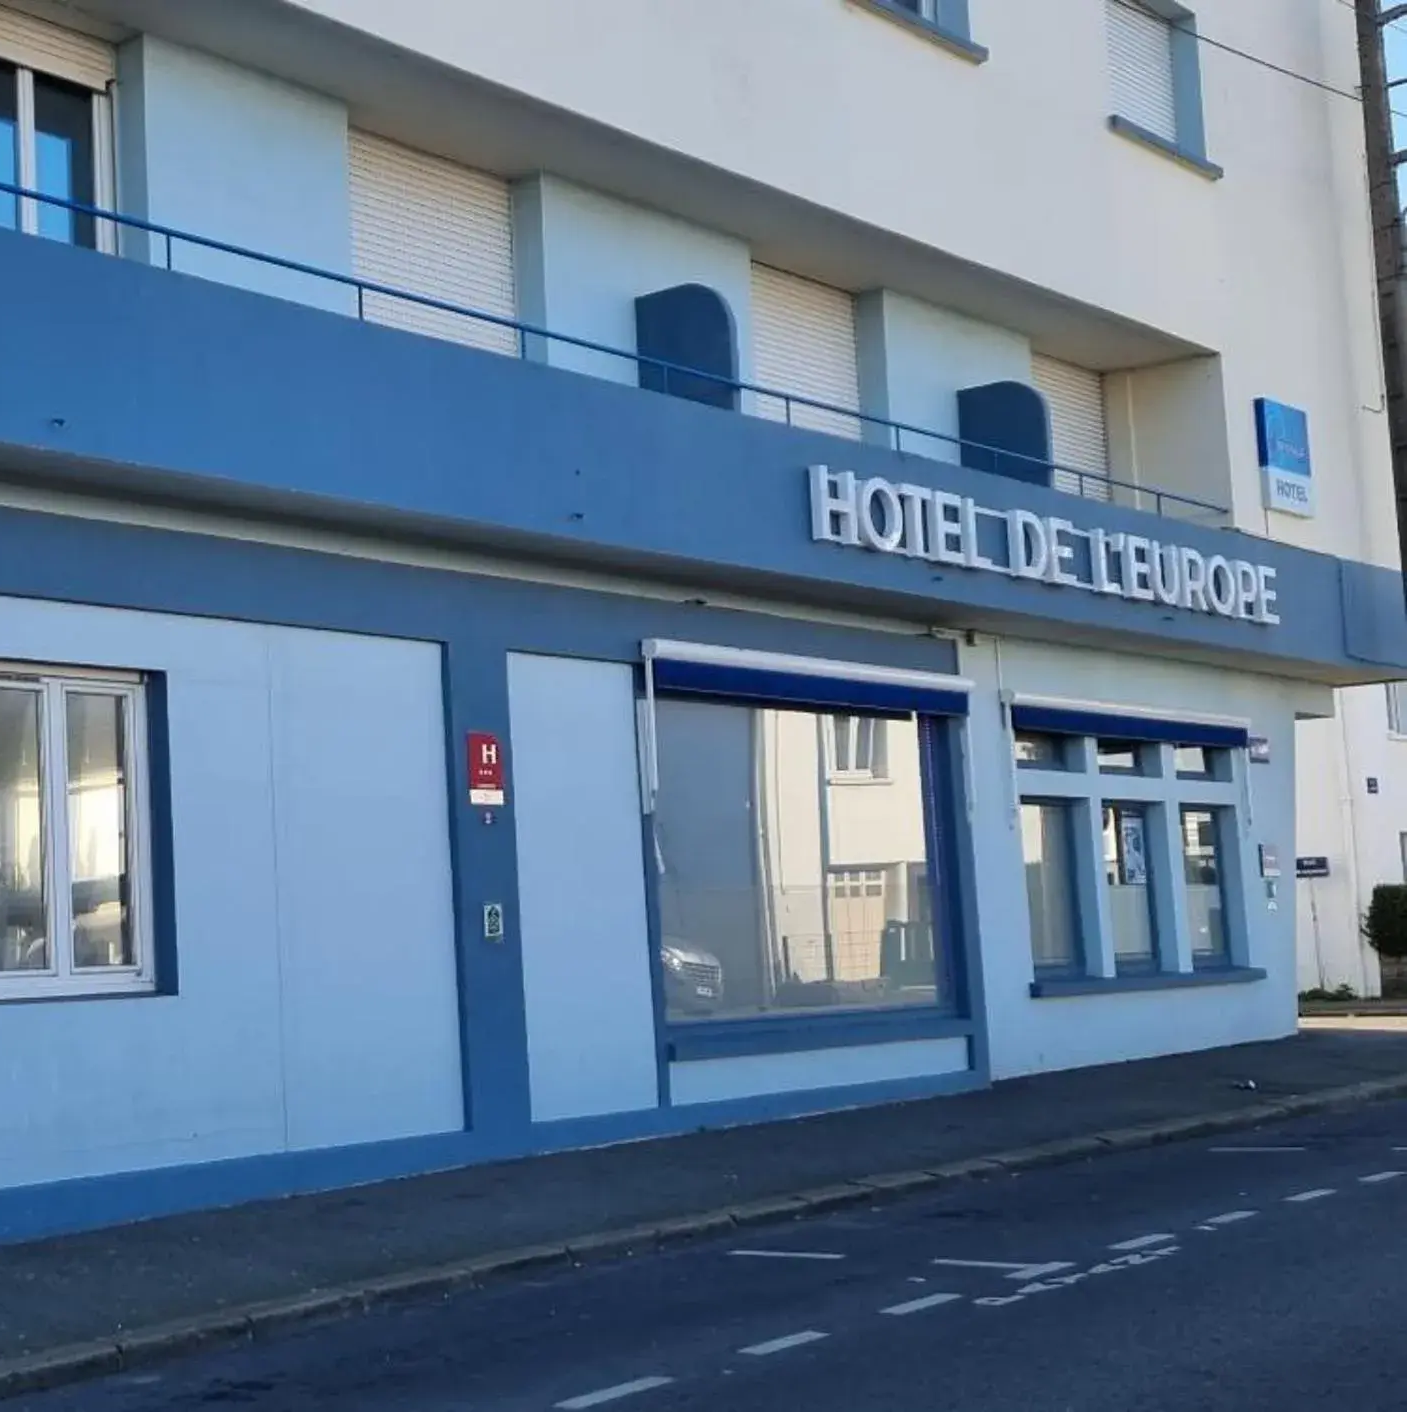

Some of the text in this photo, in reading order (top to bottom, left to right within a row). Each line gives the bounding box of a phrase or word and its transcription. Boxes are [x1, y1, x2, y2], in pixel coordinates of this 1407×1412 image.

[1276, 479, 1308, 502] HOTEL
[809, 465, 1281, 625] HOTEL DE L'EUROPE
[482, 744, 497, 764] H
